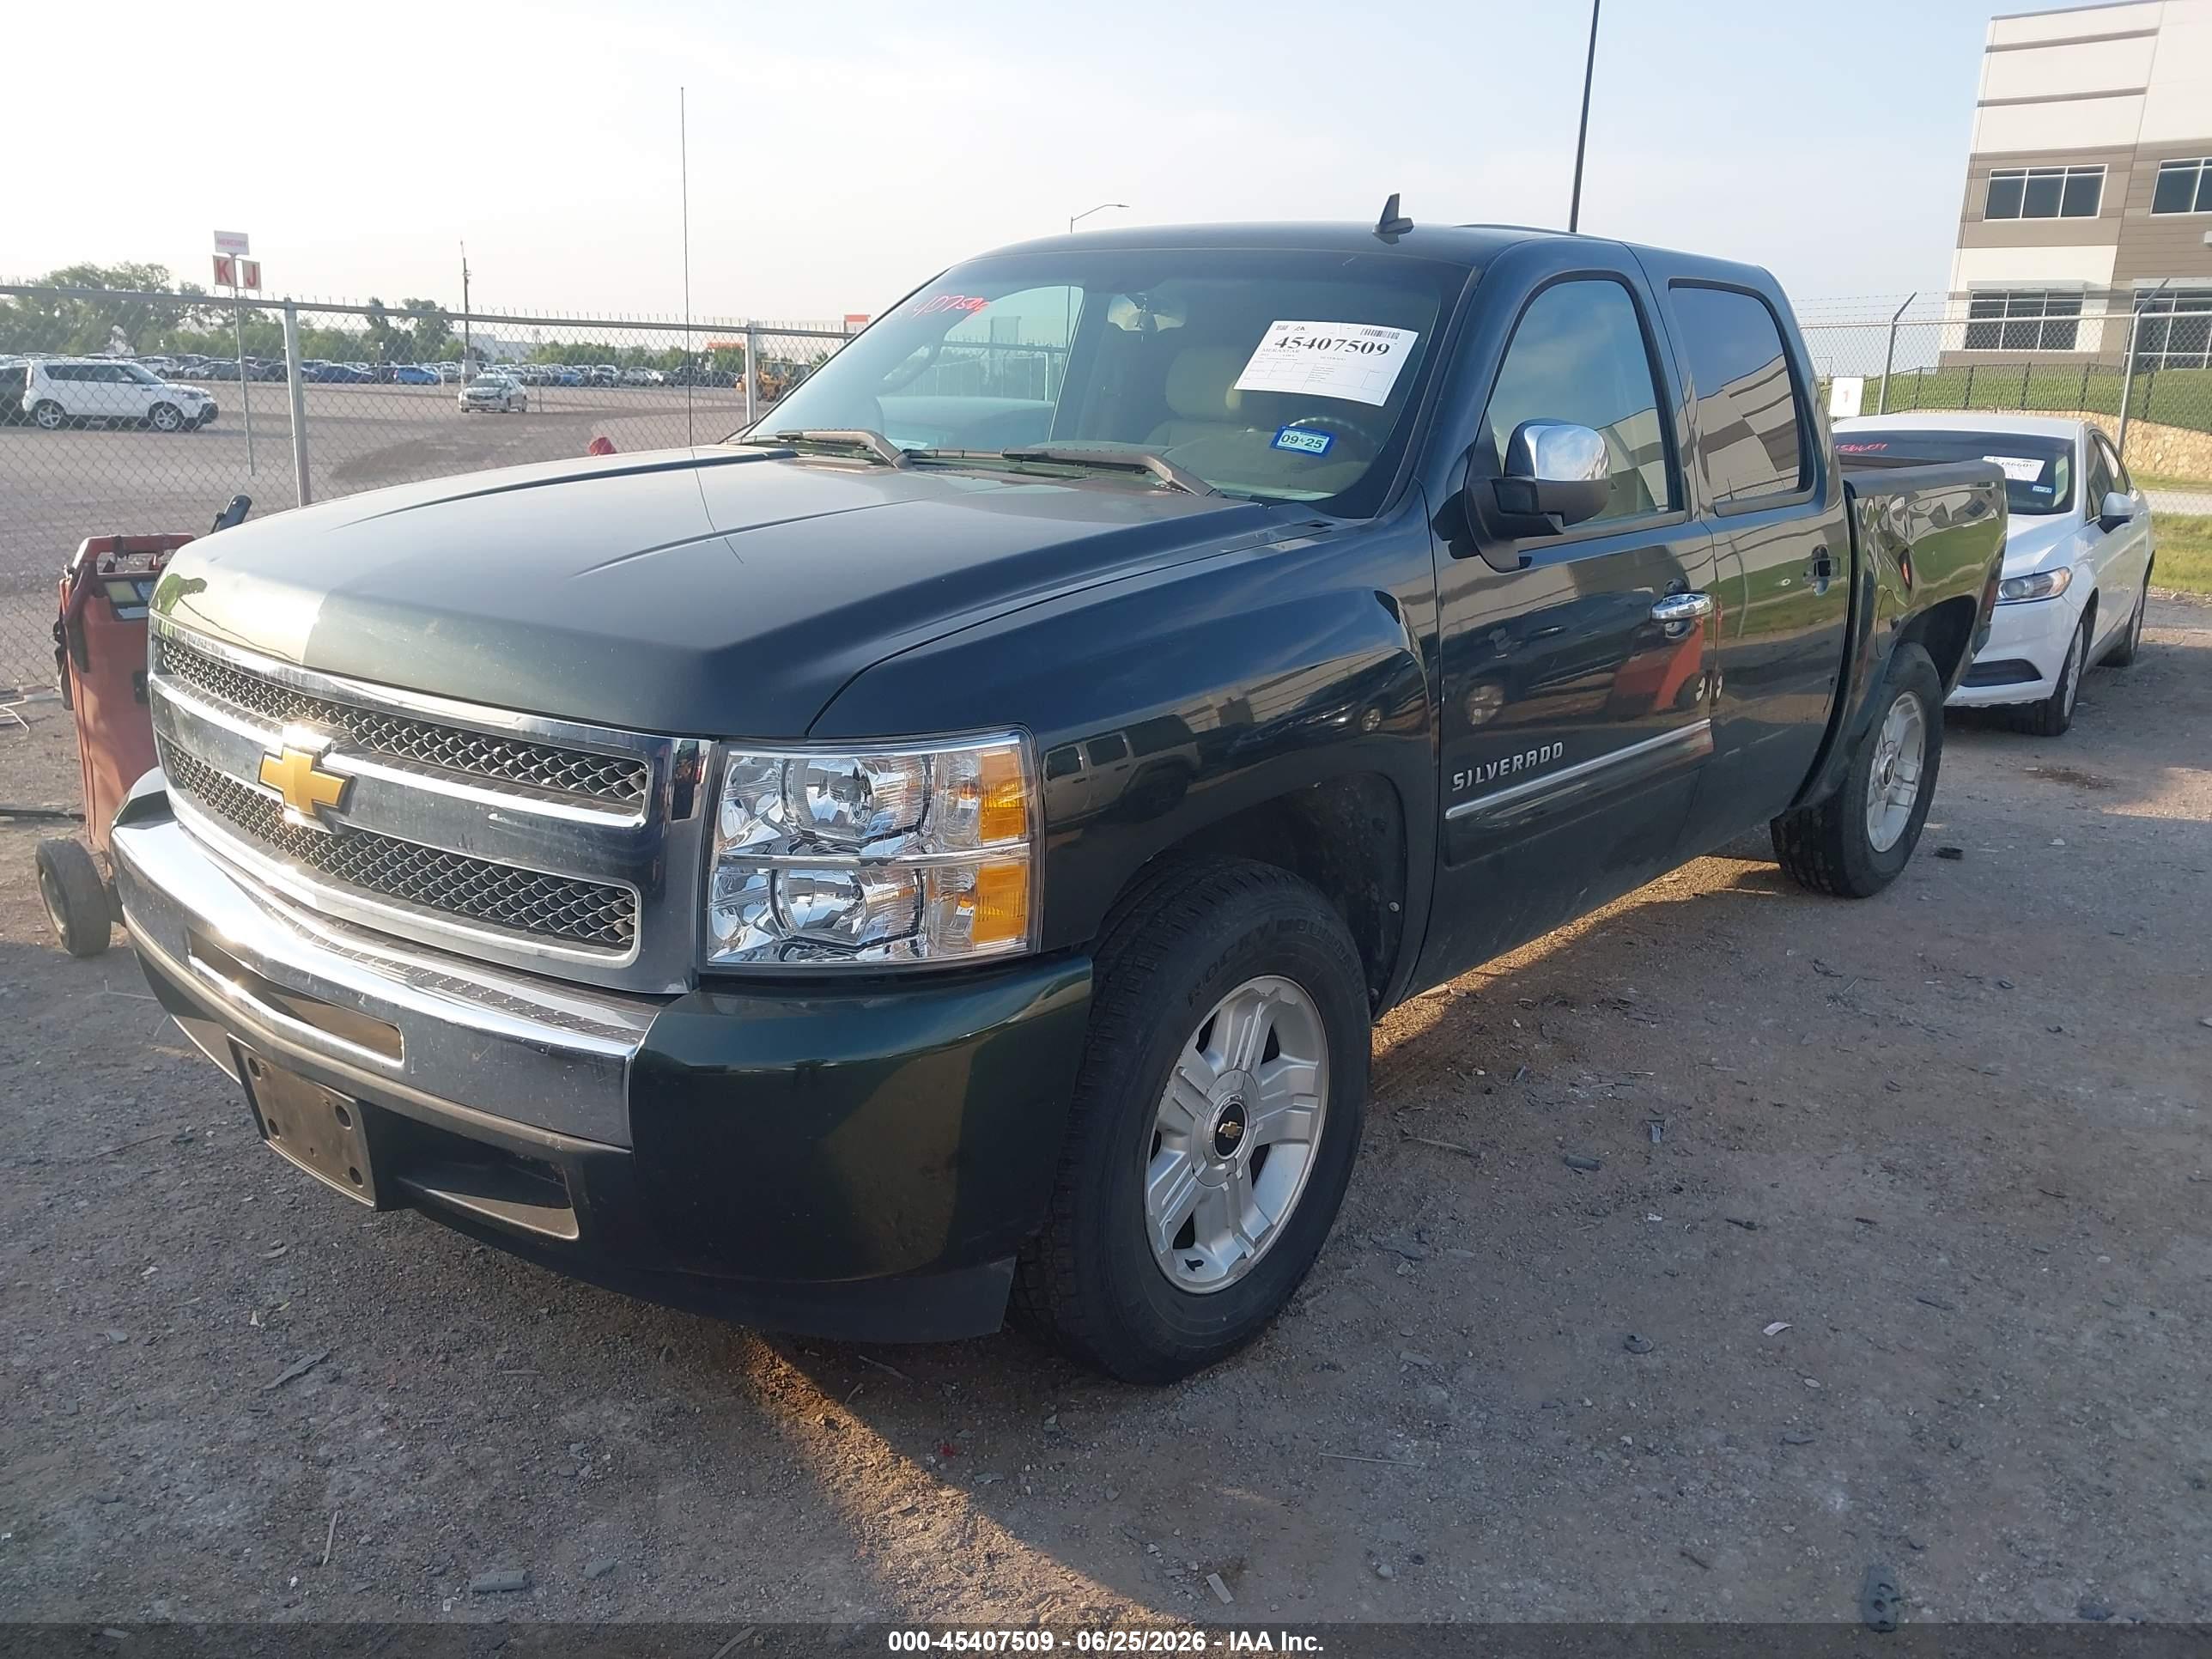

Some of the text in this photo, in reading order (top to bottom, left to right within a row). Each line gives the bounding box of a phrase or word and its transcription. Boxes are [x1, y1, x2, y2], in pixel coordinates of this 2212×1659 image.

[216, 259, 231, 283] K
[247, 264, 257, 287] J
[1274, 336, 1390, 356] 45407509
[1451, 740, 1565, 792] SILVERADO
